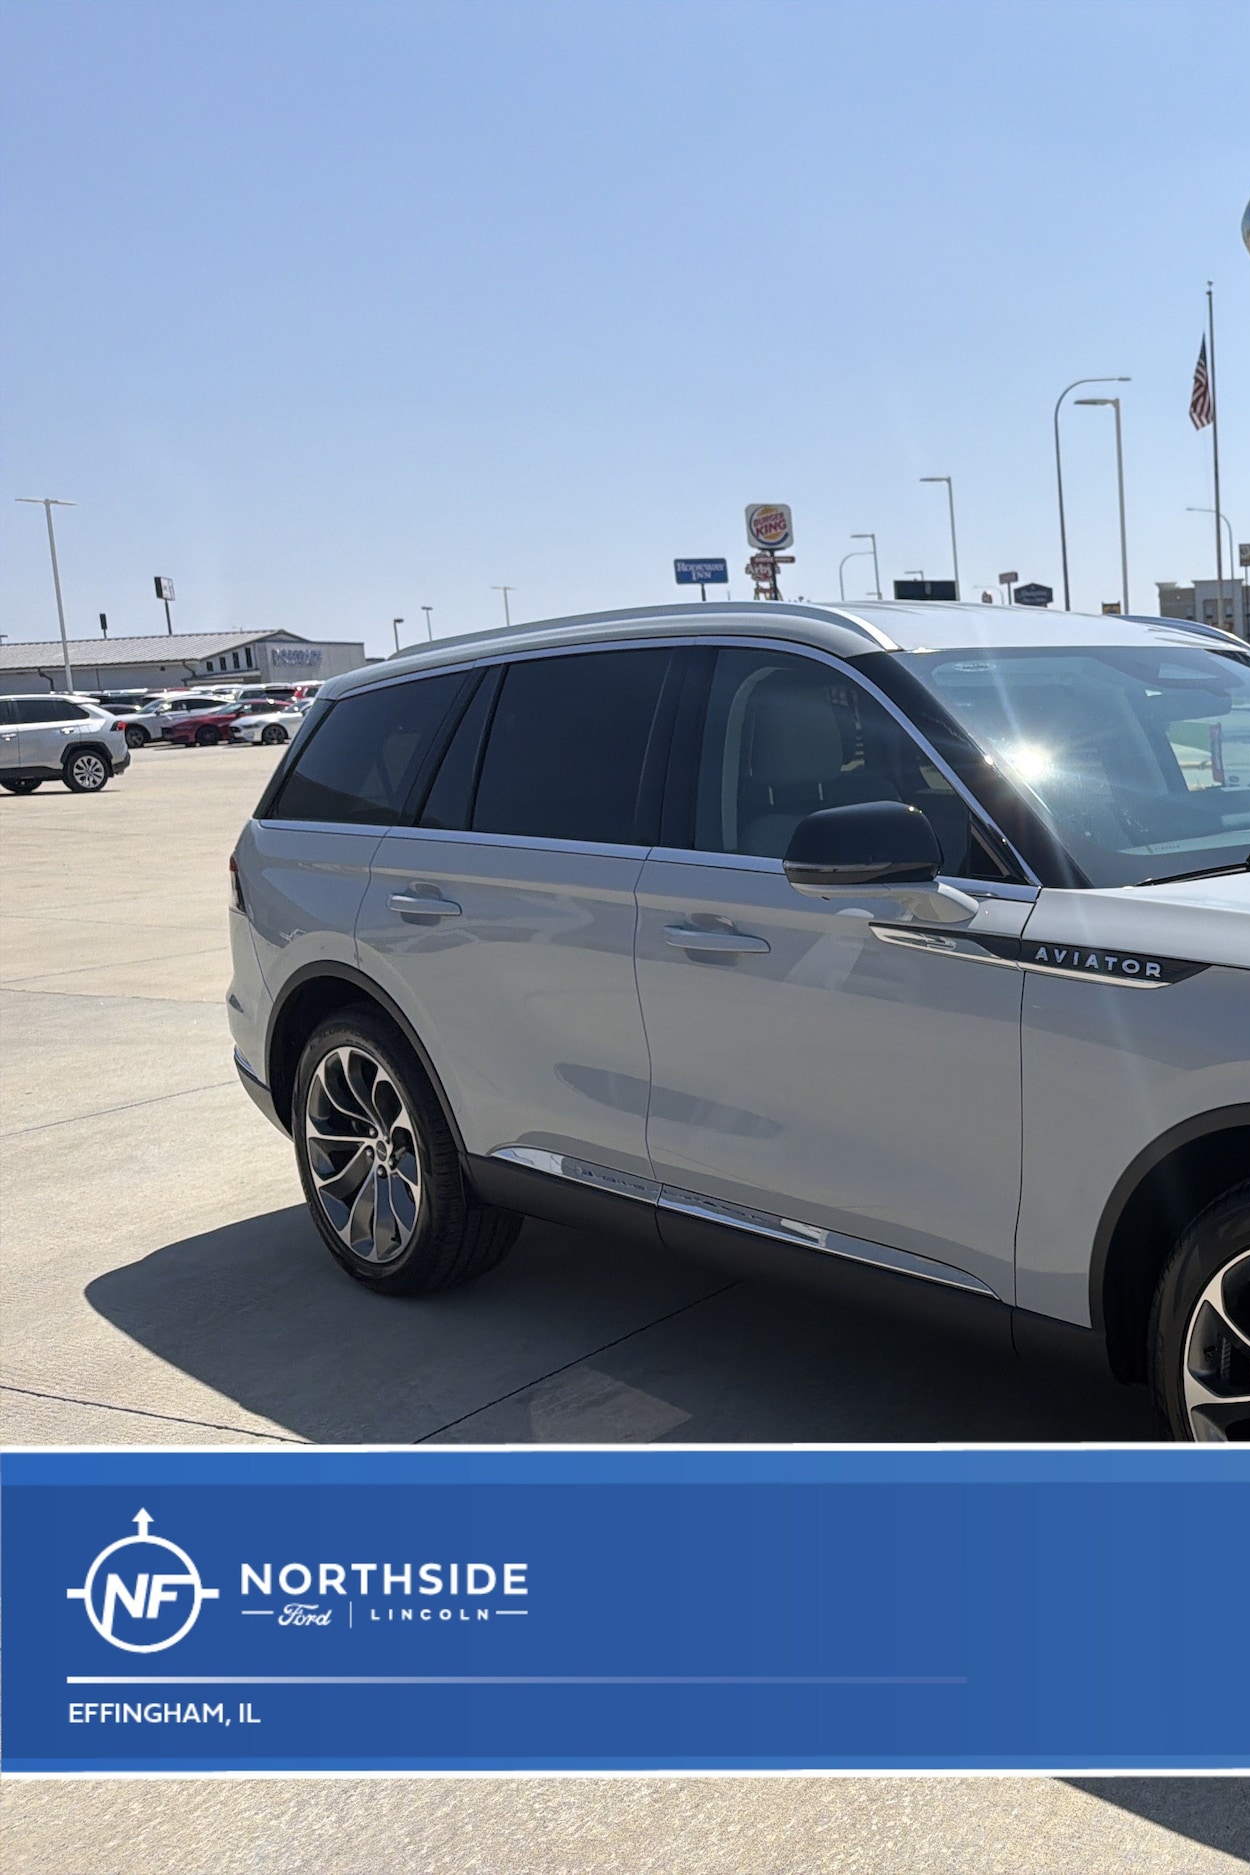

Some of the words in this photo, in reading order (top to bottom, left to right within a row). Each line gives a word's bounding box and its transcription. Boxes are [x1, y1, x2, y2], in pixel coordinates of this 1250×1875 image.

[753, 512, 784, 527] BURGER
[755, 520, 787, 537] KING
[1034, 946, 1162, 978] AVIATOR
